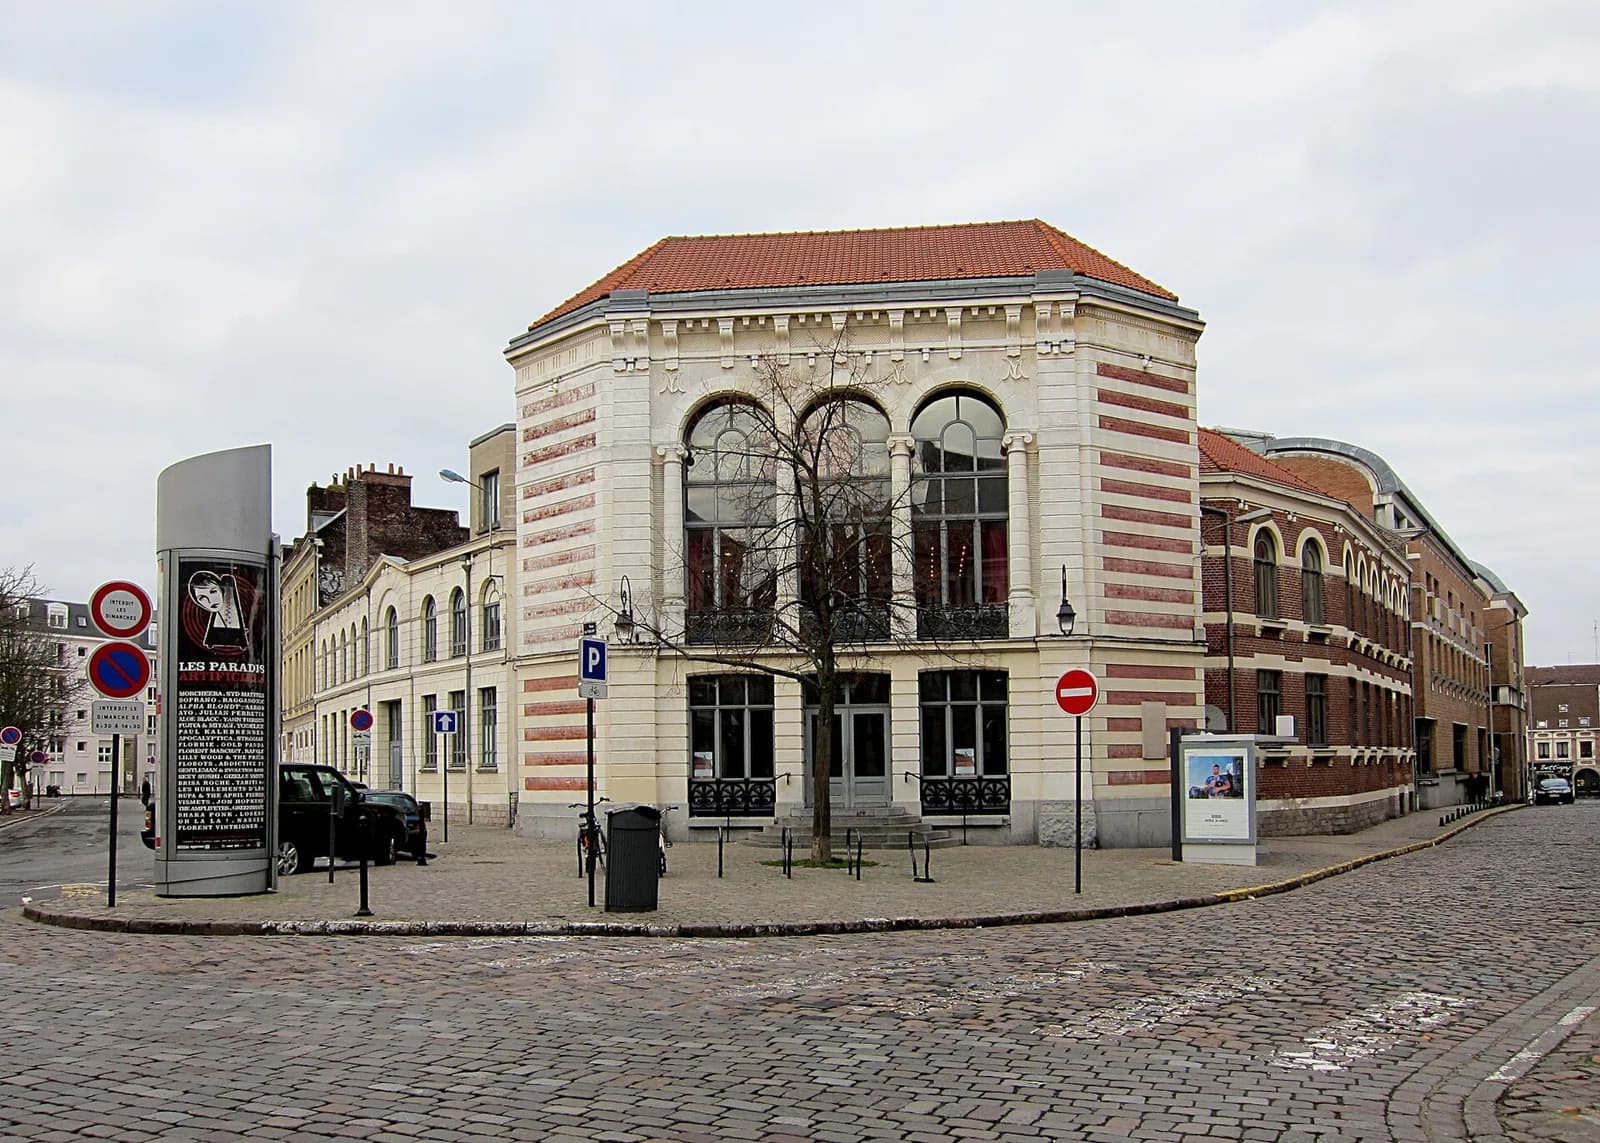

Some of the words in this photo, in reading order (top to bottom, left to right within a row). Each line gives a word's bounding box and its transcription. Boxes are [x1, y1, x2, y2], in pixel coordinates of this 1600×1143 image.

[105, 613, 137, 621] DIMANCHES
[588, 647, 600, 673] P
[179, 662, 205, 672] LES
[209, 662, 265, 674] PARADIS
